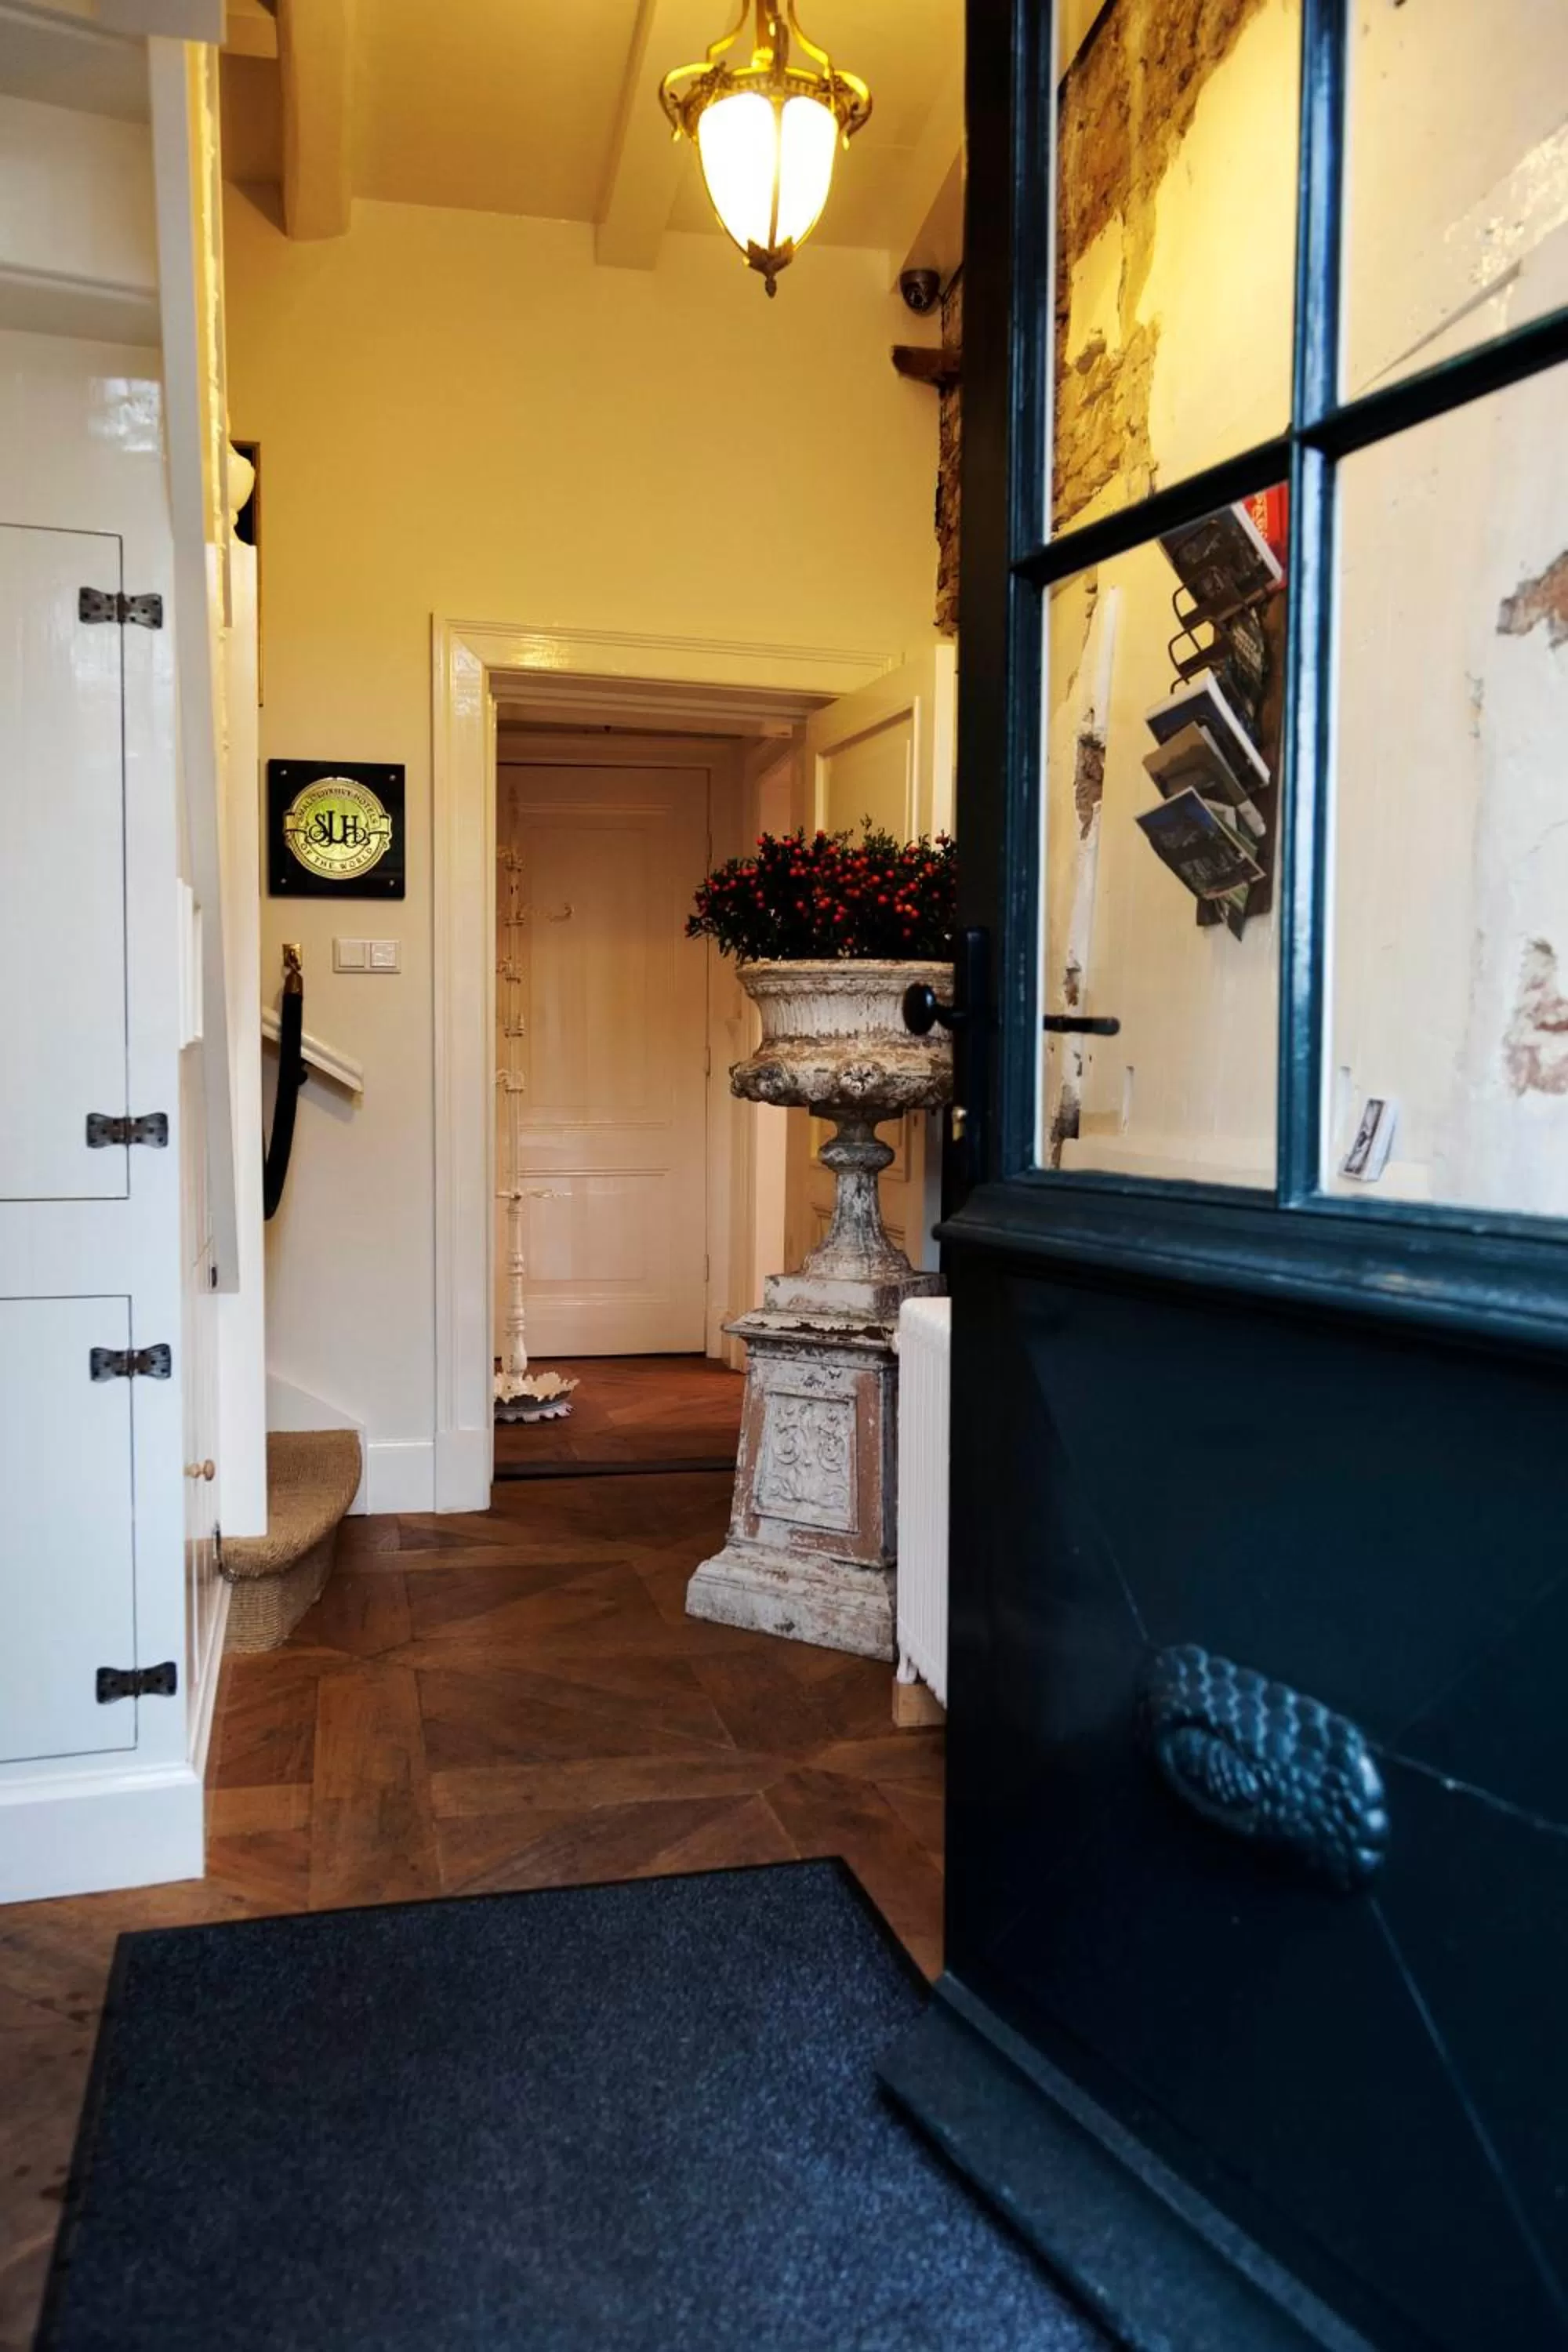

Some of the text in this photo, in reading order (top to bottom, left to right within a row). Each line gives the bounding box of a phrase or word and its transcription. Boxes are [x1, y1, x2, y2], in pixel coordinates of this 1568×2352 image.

[354, 793, 378, 824] HOTELS
[307, 811, 368, 848] SLH
[301, 843, 372, 869] OF THE WORLD
